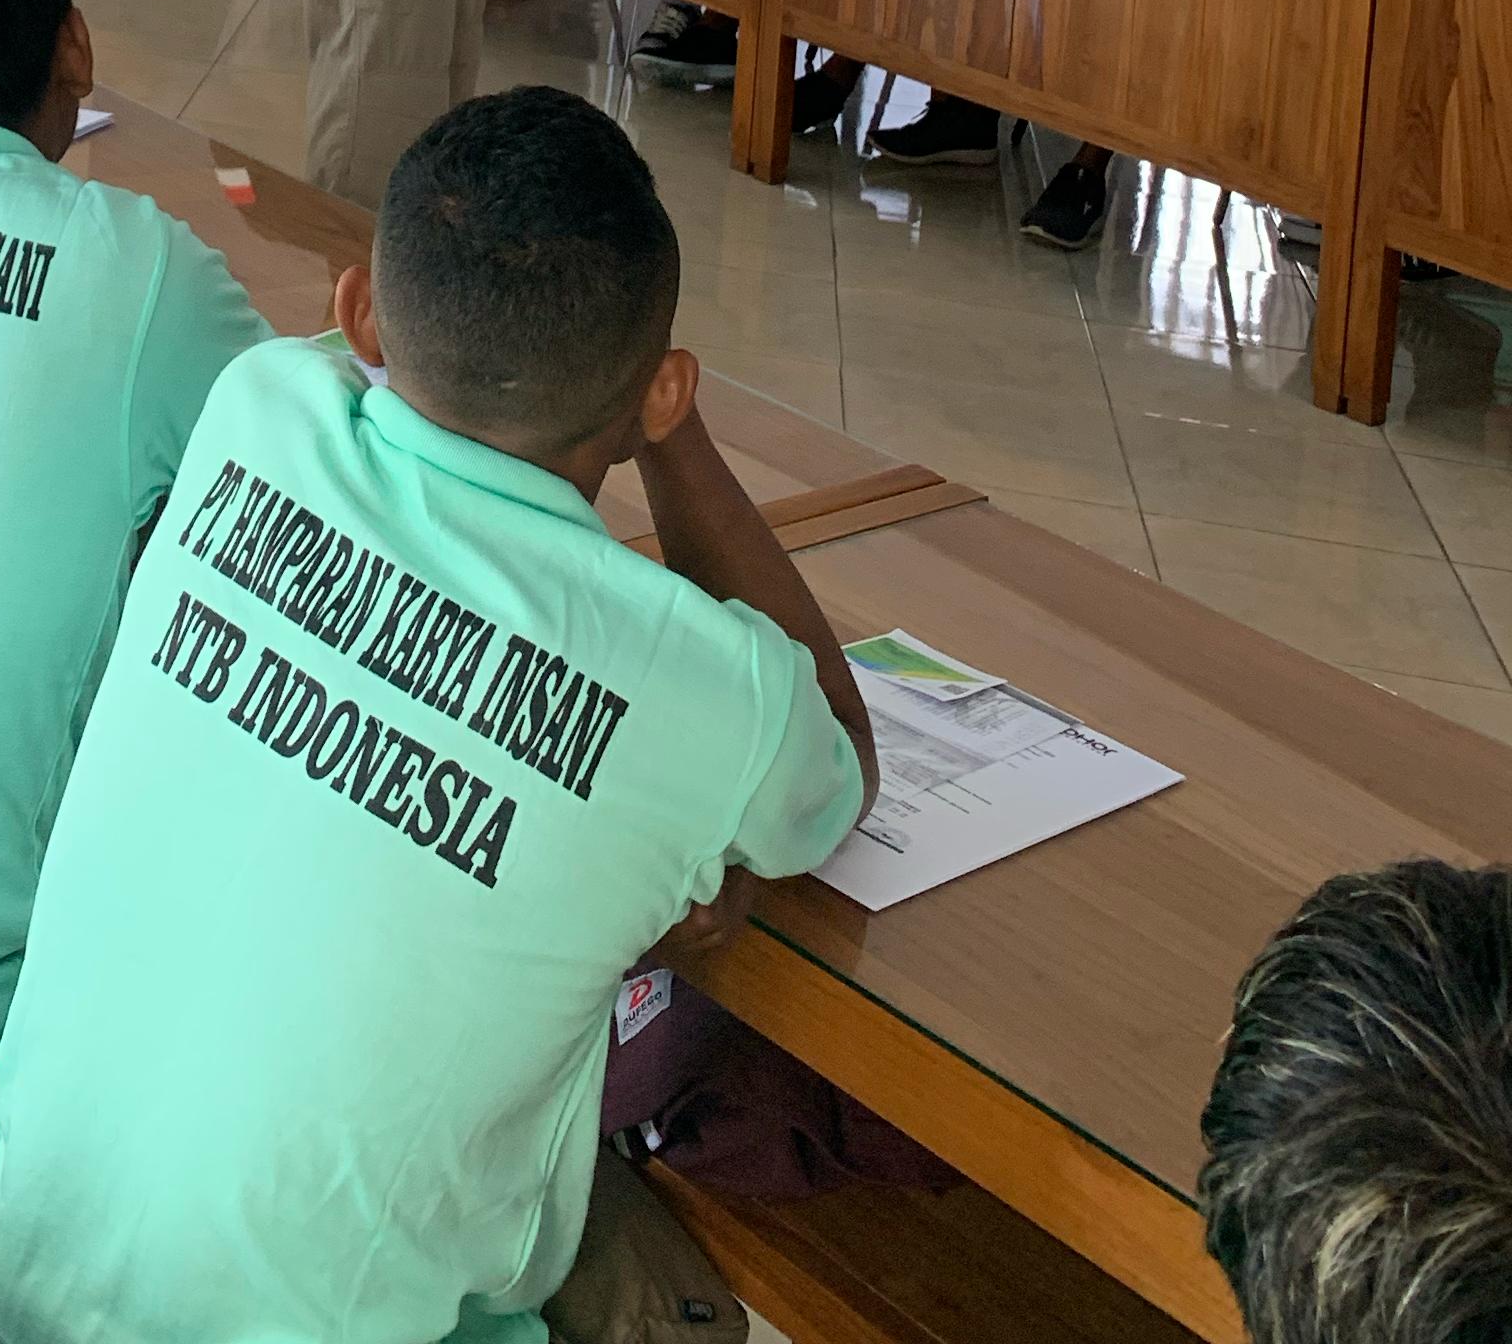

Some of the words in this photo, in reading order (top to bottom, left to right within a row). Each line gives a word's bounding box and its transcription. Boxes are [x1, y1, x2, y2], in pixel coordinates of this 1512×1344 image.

[151, 590, 247, 705] NTB
[226, 646, 518, 889] INDONESIA
[210, 476, 395, 655] HAMPARAN
[357, 572, 497, 721] KARYA
[467, 633, 630, 802] INSANI
